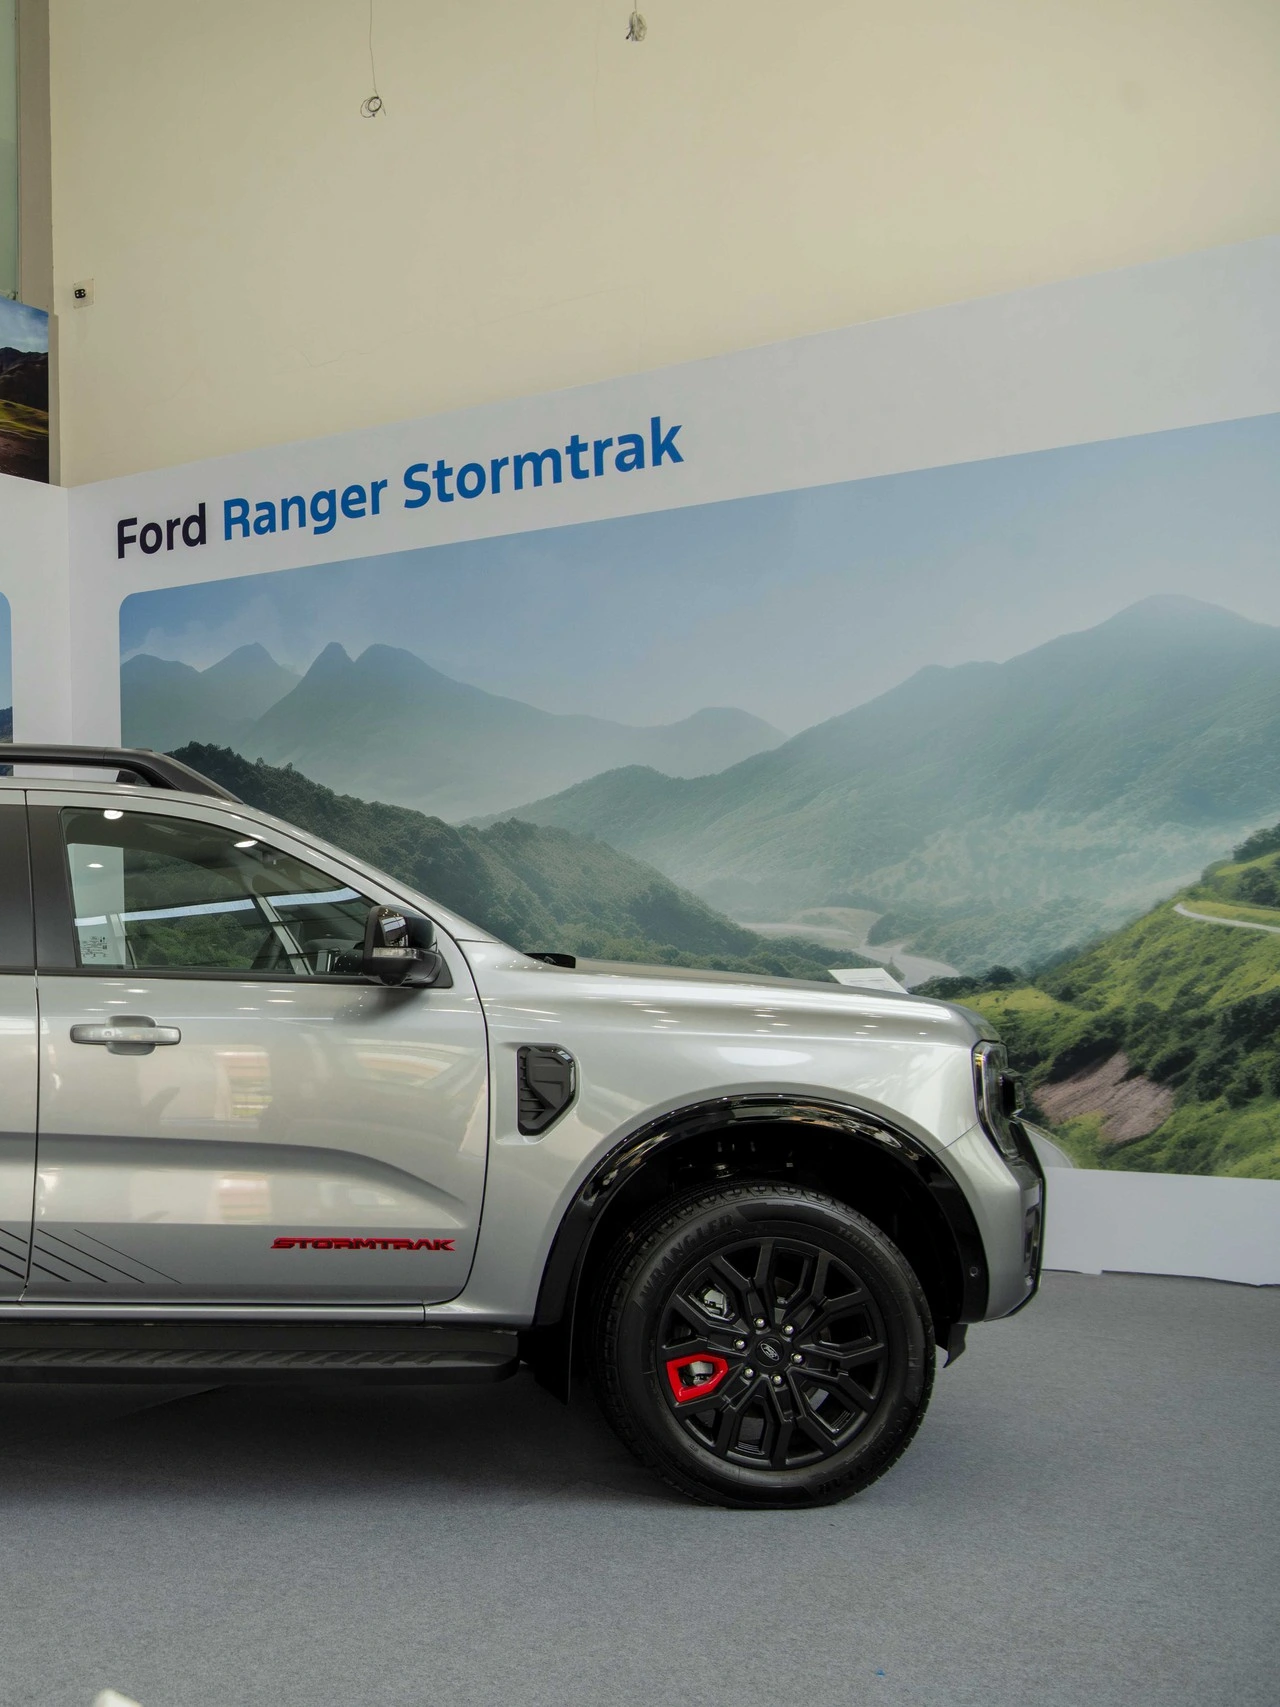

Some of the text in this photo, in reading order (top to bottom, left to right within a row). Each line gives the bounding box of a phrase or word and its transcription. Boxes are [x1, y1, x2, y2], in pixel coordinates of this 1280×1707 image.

[117, 416, 684, 560] Ford Ranger Stormtrak
[271, 1237, 455, 1251] STORMTRAK
